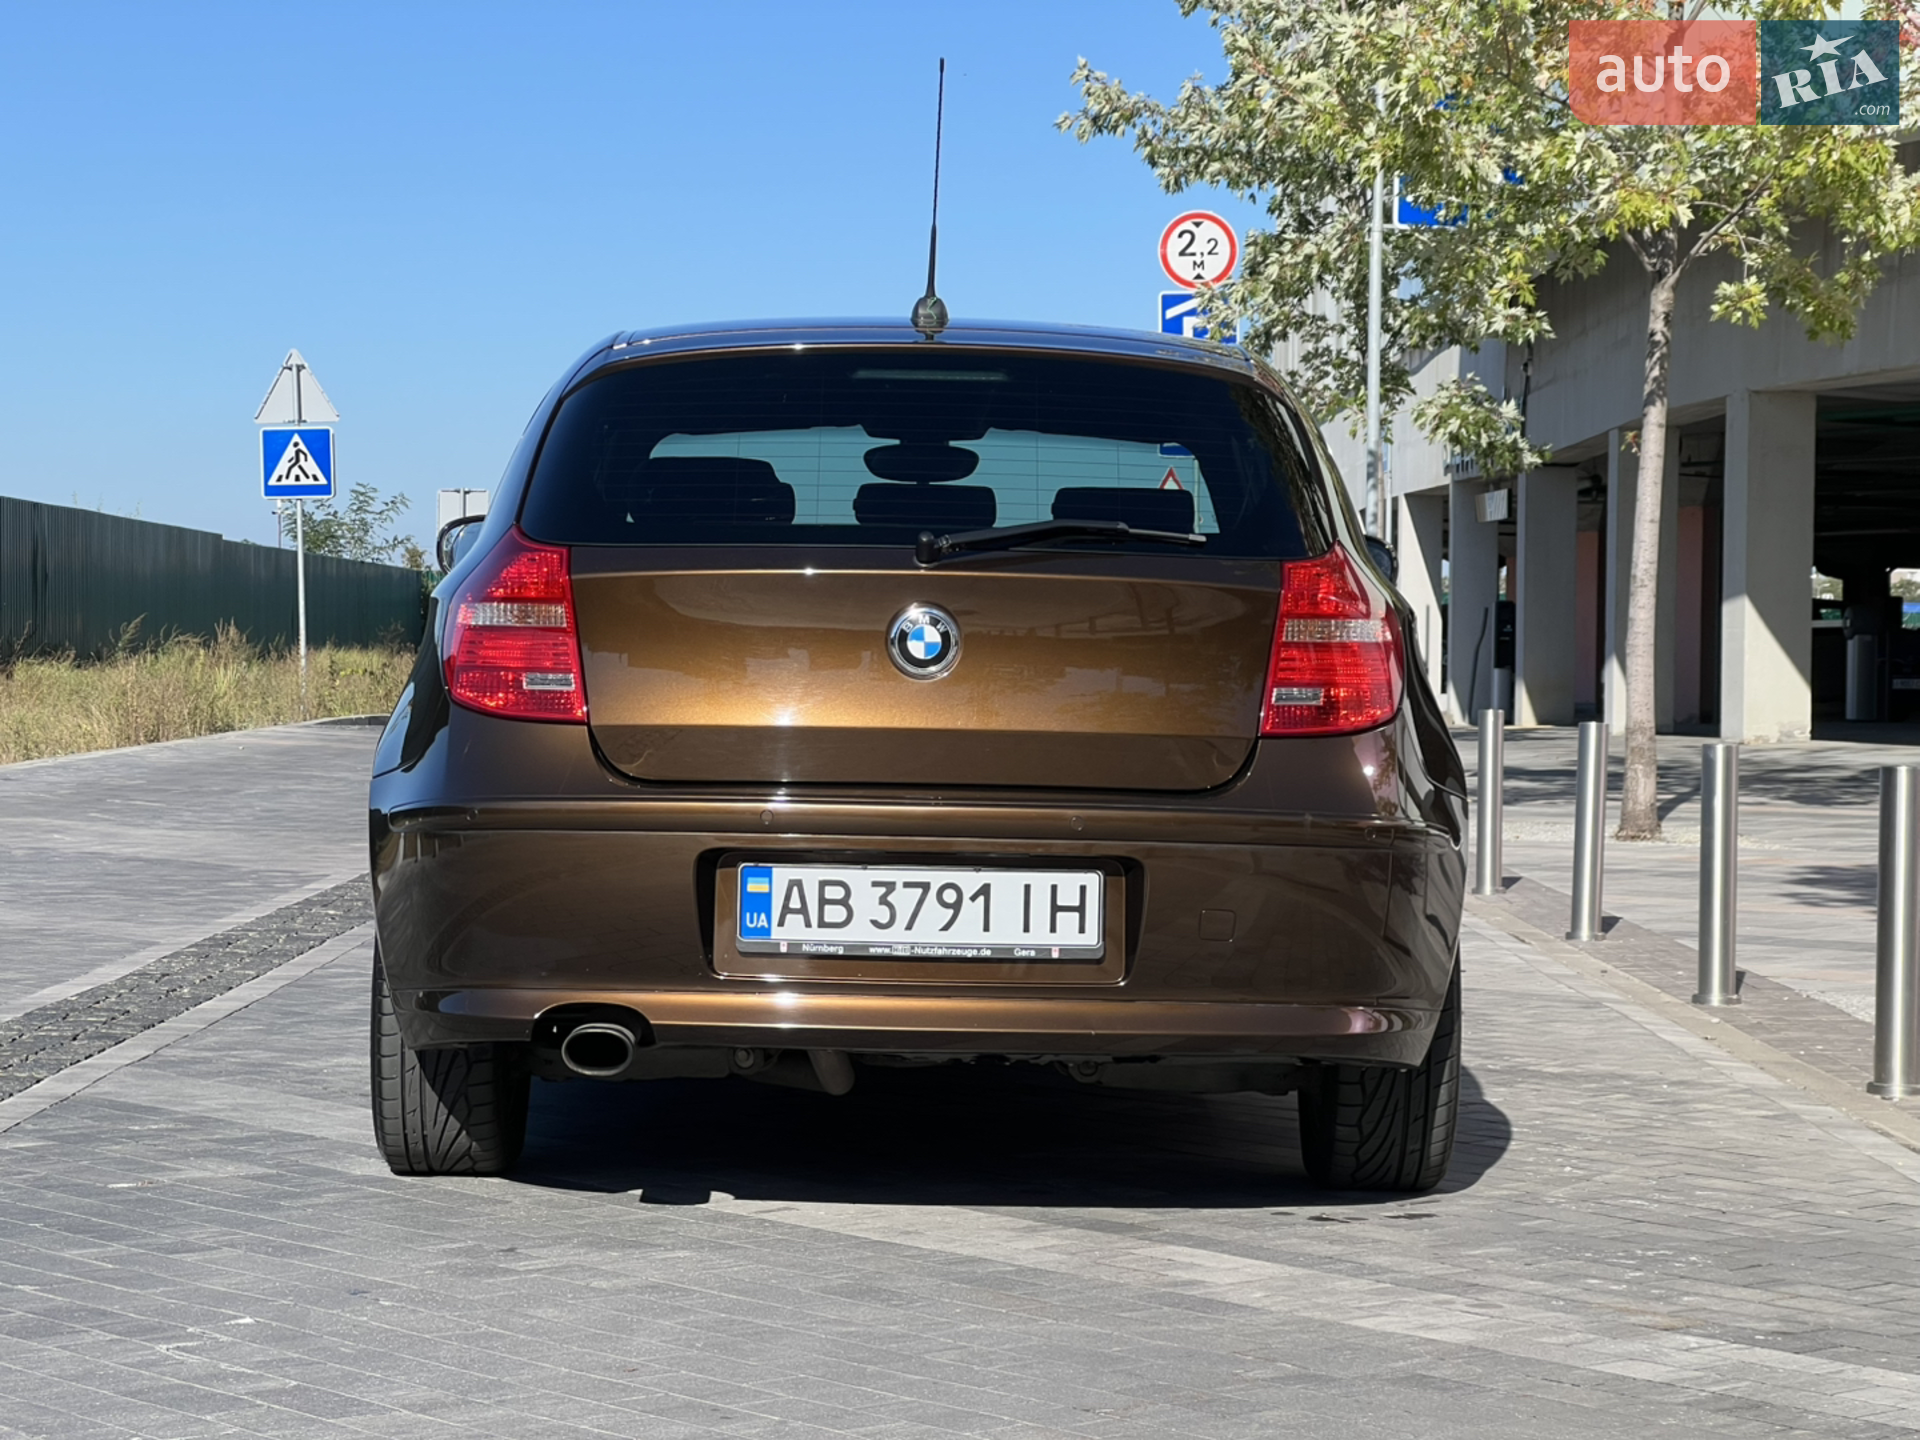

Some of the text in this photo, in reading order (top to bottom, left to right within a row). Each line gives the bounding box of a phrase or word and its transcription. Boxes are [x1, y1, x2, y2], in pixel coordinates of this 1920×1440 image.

[1177, 229, 1219, 258] 2,2
[902, 614, 948, 633] BMW
[776, 878, 1087, 934] AB 3791 IH
[746, 912, 768, 928] UA
[802, 943, 844, 955] Nürnberg
